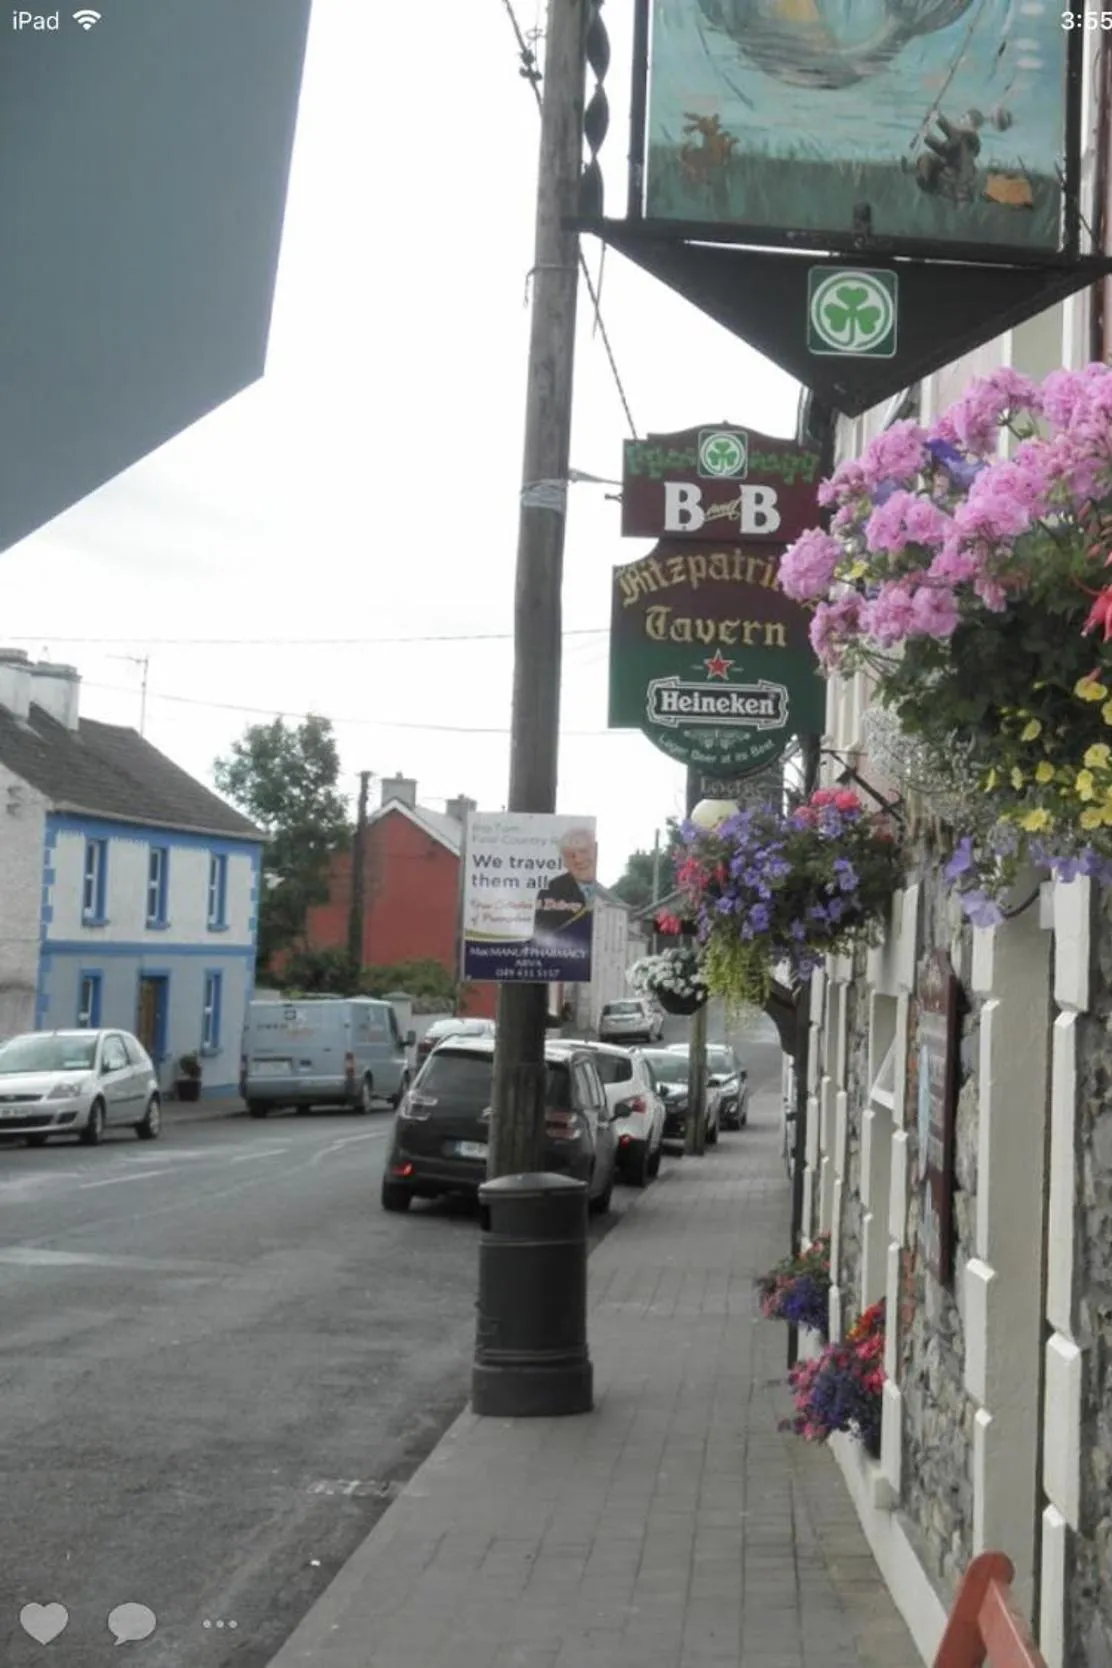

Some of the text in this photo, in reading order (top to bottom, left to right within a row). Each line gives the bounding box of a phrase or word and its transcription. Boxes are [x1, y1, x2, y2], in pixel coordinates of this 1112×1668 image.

[663, 481, 705, 533] B
[739, 484, 781, 535] B
[644, 604, 788, 648] Tavern
[660, 689, 776, 716] Heineken
[471, 853, 563, 870] We travel
[471, 873, 548, 889] them all
